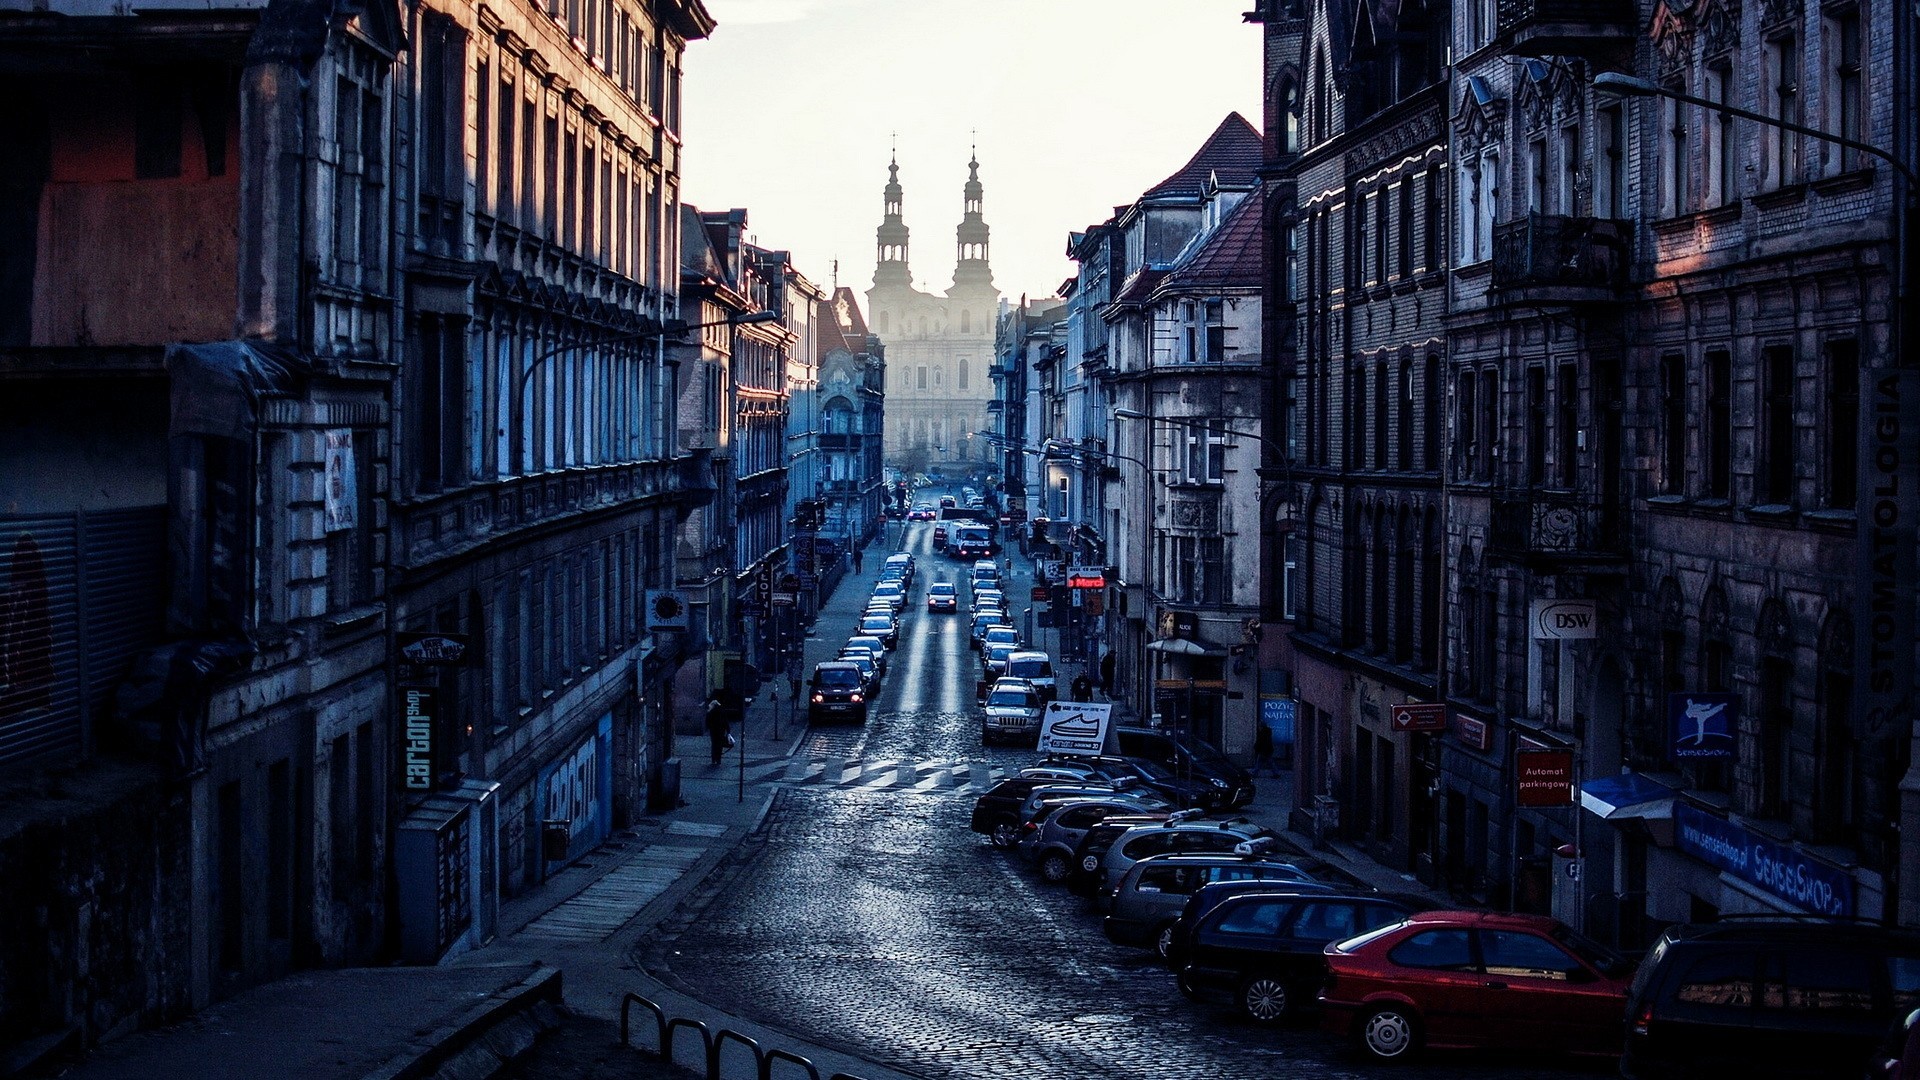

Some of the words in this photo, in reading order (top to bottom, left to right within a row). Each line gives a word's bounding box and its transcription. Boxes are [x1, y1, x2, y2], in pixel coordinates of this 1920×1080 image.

[1871, 373, 1901, 694] STOMATOLOGIA
[1555, 613, 1593, 629] DSW
[1526, 767, 1564, 776] Automat
[1519, 780, 1570, 790] parkingowy
